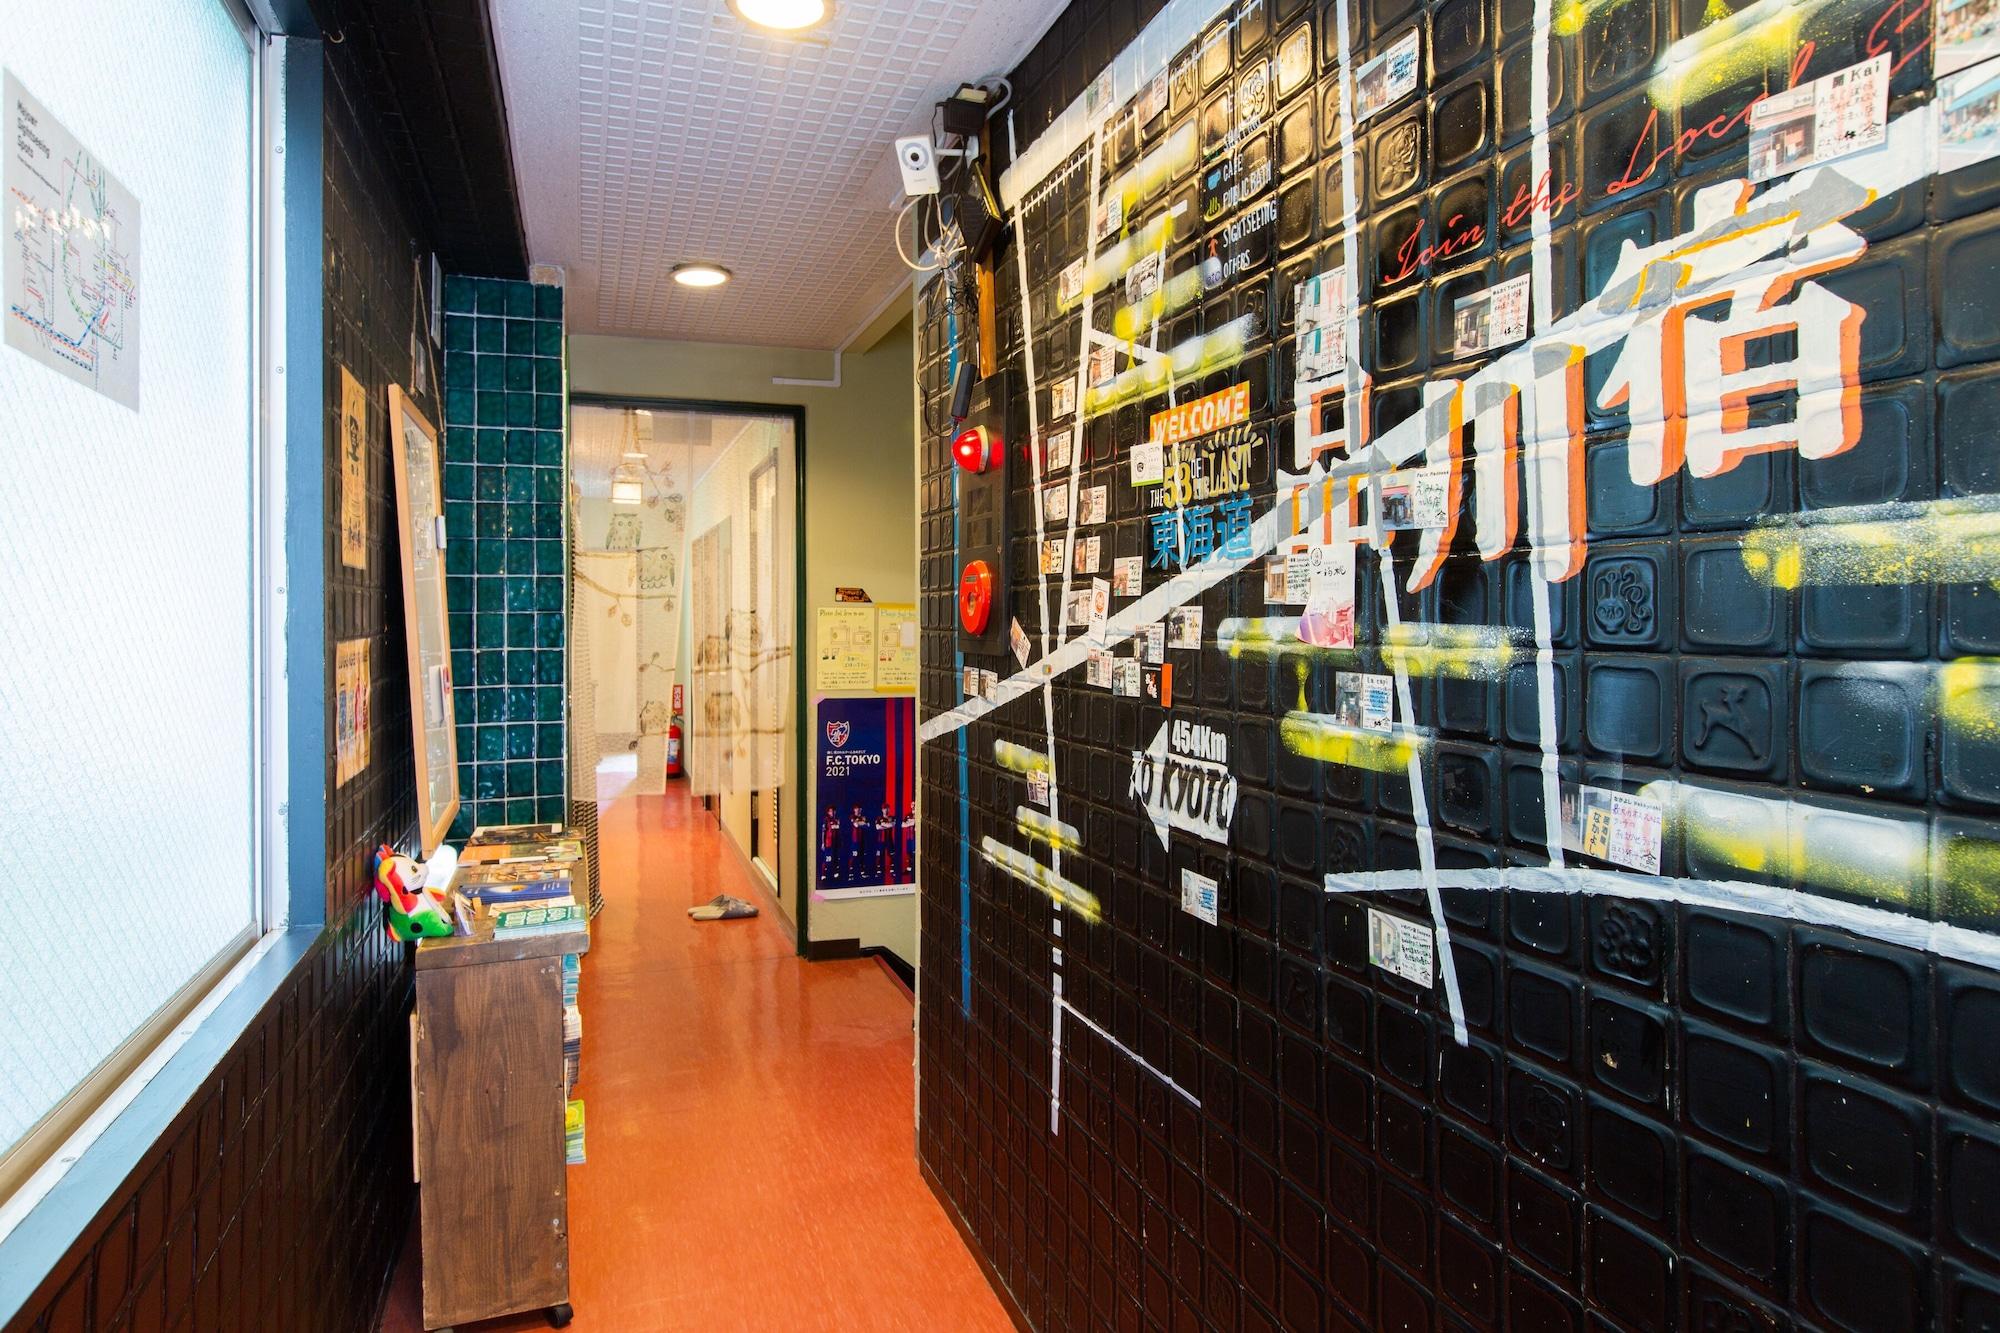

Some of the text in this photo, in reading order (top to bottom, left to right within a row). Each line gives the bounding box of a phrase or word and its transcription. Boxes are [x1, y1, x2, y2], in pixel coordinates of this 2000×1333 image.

[1222, 199, 1278, 249] SIGHTSEEING
[1501, 168, 1583, 228] the
[1223, 248, 1251, 279] OTHERS
[1153, 390, 1246, 443] WELCOME
[1150, 488, 1165, 508] THE
[1208, 444, 1253, 496] LAST
[1150, 492, 1254, 571] 東海道
[825, 766, 850, 777] 2021
[826, 754, 881, 766] F.C.TOKYO
[1159, 757, 1238, 831] KYOTO
